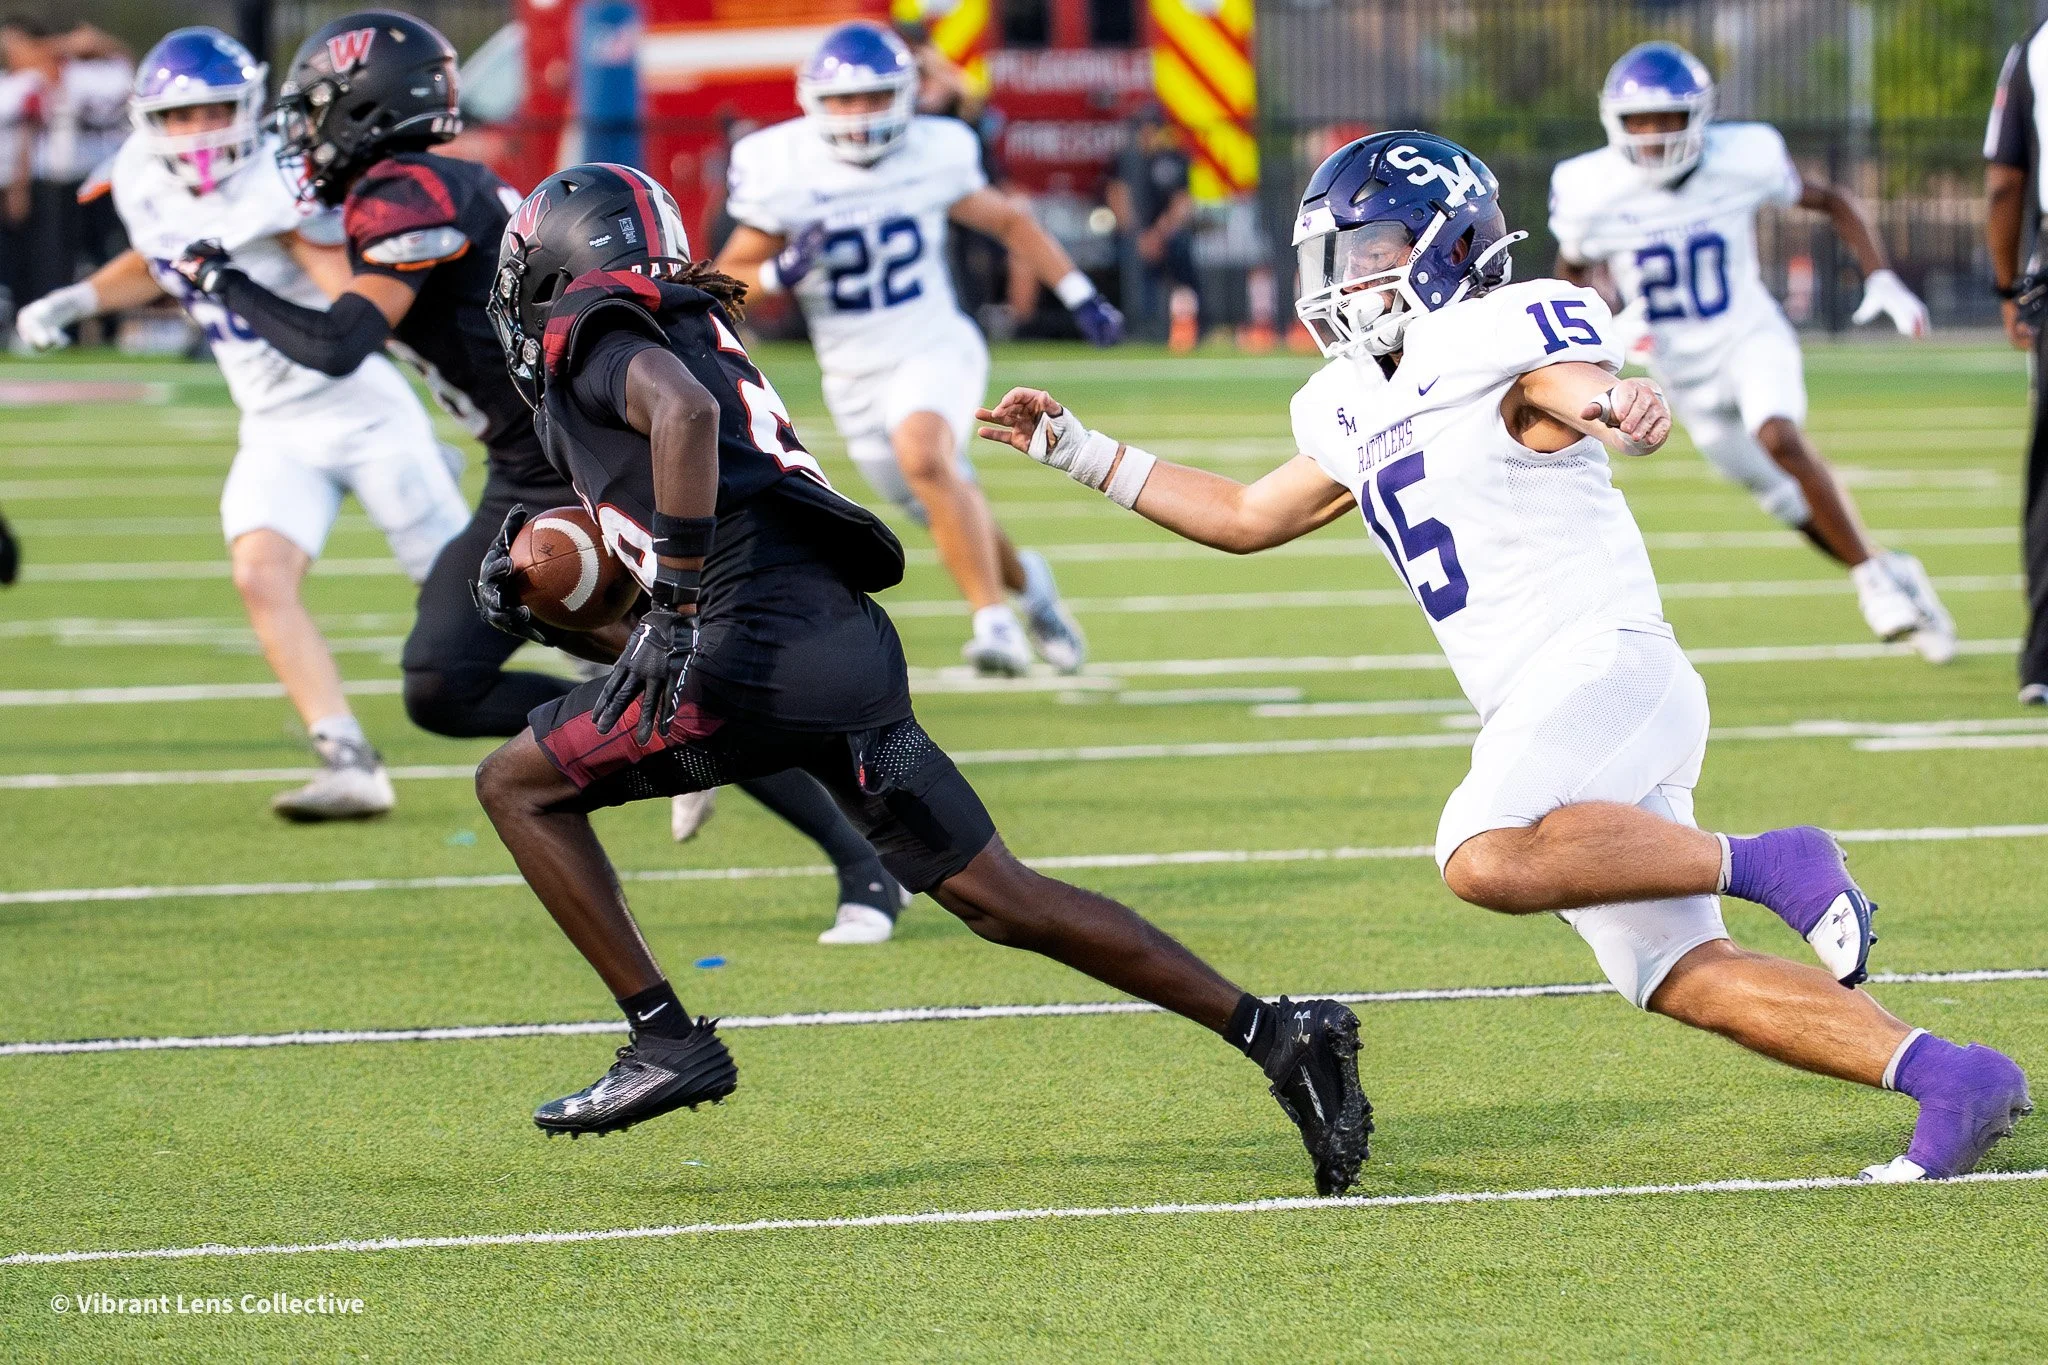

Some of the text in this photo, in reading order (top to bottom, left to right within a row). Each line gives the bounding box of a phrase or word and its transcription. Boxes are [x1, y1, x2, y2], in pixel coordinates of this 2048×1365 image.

[326, 27, 377, 74] W
[826, 216, 924, 312] 22
[1635, 231, 1730, 322] 20
[1525, 300, 1602, 355] 15
[1357, 418, 1414, 474] RATTLERS
[1361, 450, 1470, 622] 15
